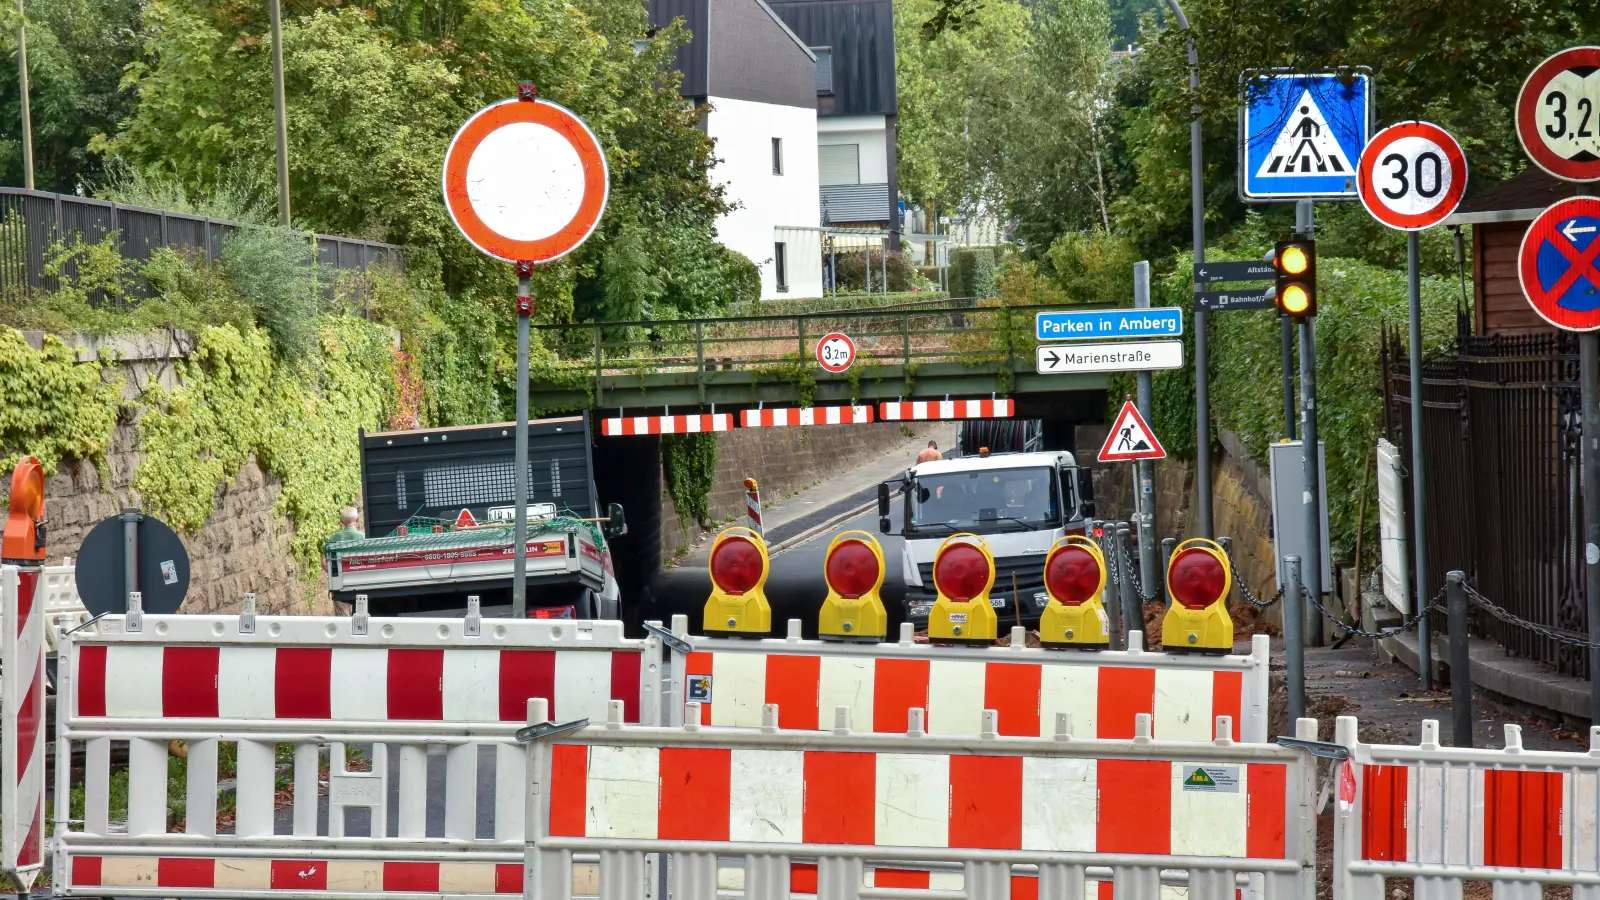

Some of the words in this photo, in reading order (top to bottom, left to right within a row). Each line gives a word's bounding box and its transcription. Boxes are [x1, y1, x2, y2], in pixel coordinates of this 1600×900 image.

[1545, 90, 1600, 141] 3,2
[1381, 151, 1442, 199] 30
[1043, 318, 1093, 333] Parken
[1099, 318, 1112, 331] in
[1119, 316, 1176, 332] Amberg
[1065, 350, 1151, 365] Marienstraße
[502, 546, 538, 555] ZELIN
